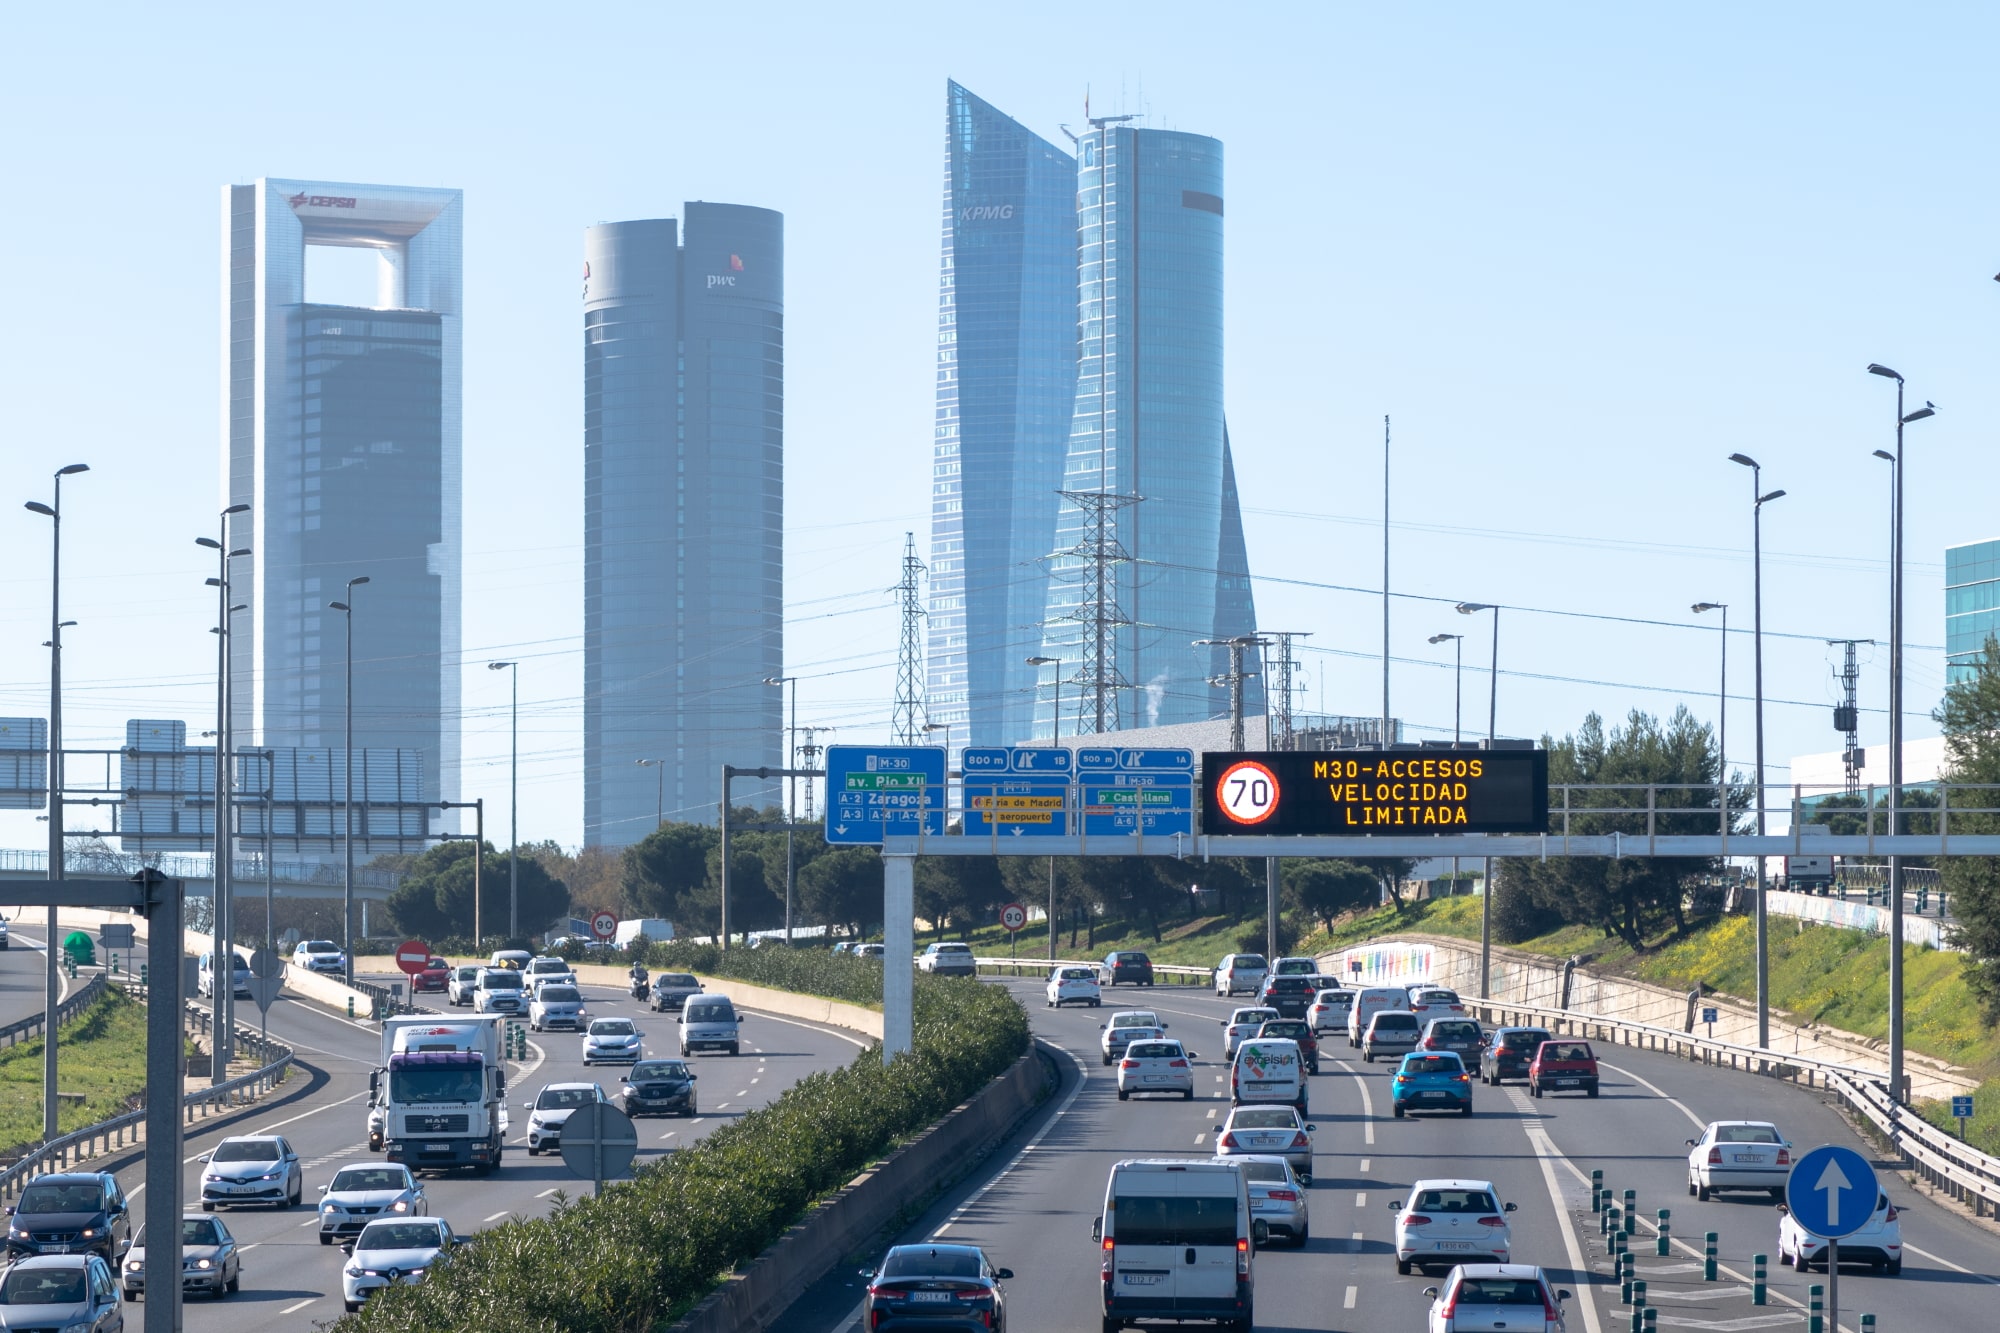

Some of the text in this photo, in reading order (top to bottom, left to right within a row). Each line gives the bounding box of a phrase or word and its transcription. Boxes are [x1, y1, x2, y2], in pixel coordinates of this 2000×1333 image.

[308, 196, 357, 208] CEPSA
[961, 204, 1014, 221] KPMG
[707, 274, 736, 288] pwc
[880, 759, 908, 768] M-30
[968, 756, 1003, 765] 800 m
[1053, 756, 1066, 765] 1B
[1083, 755, 1100, 763] 500
[1314, 760, 1483, 778] M30-ACCESOS
[847, 777, 869, 787] av.
[1130, 778, 1153, 786] M-30
[1113, 793, 1170, 802] Castllana
[1230, 779, 1268, 807] 70
[1330, 784, 1467, 801] VELOCIDAD
[840, 792, 932, 807] A-2 Zaragoza
[985, 798, 1062, 807] Fria de Madrid
[843, 810, 862, 819] A-3
[872, 810, 892, 819] A-4
[1000, 813, 1052, 822] aeropuerto
[1346, 807, 1467, 824] LIMITADA
[1006, 912, 1022, 922] 90
[597, 920, 613, 930] 90
[1244, 1053, 1295, 1066] excelsior
[1959, 1106, 1967, 1115] 5
